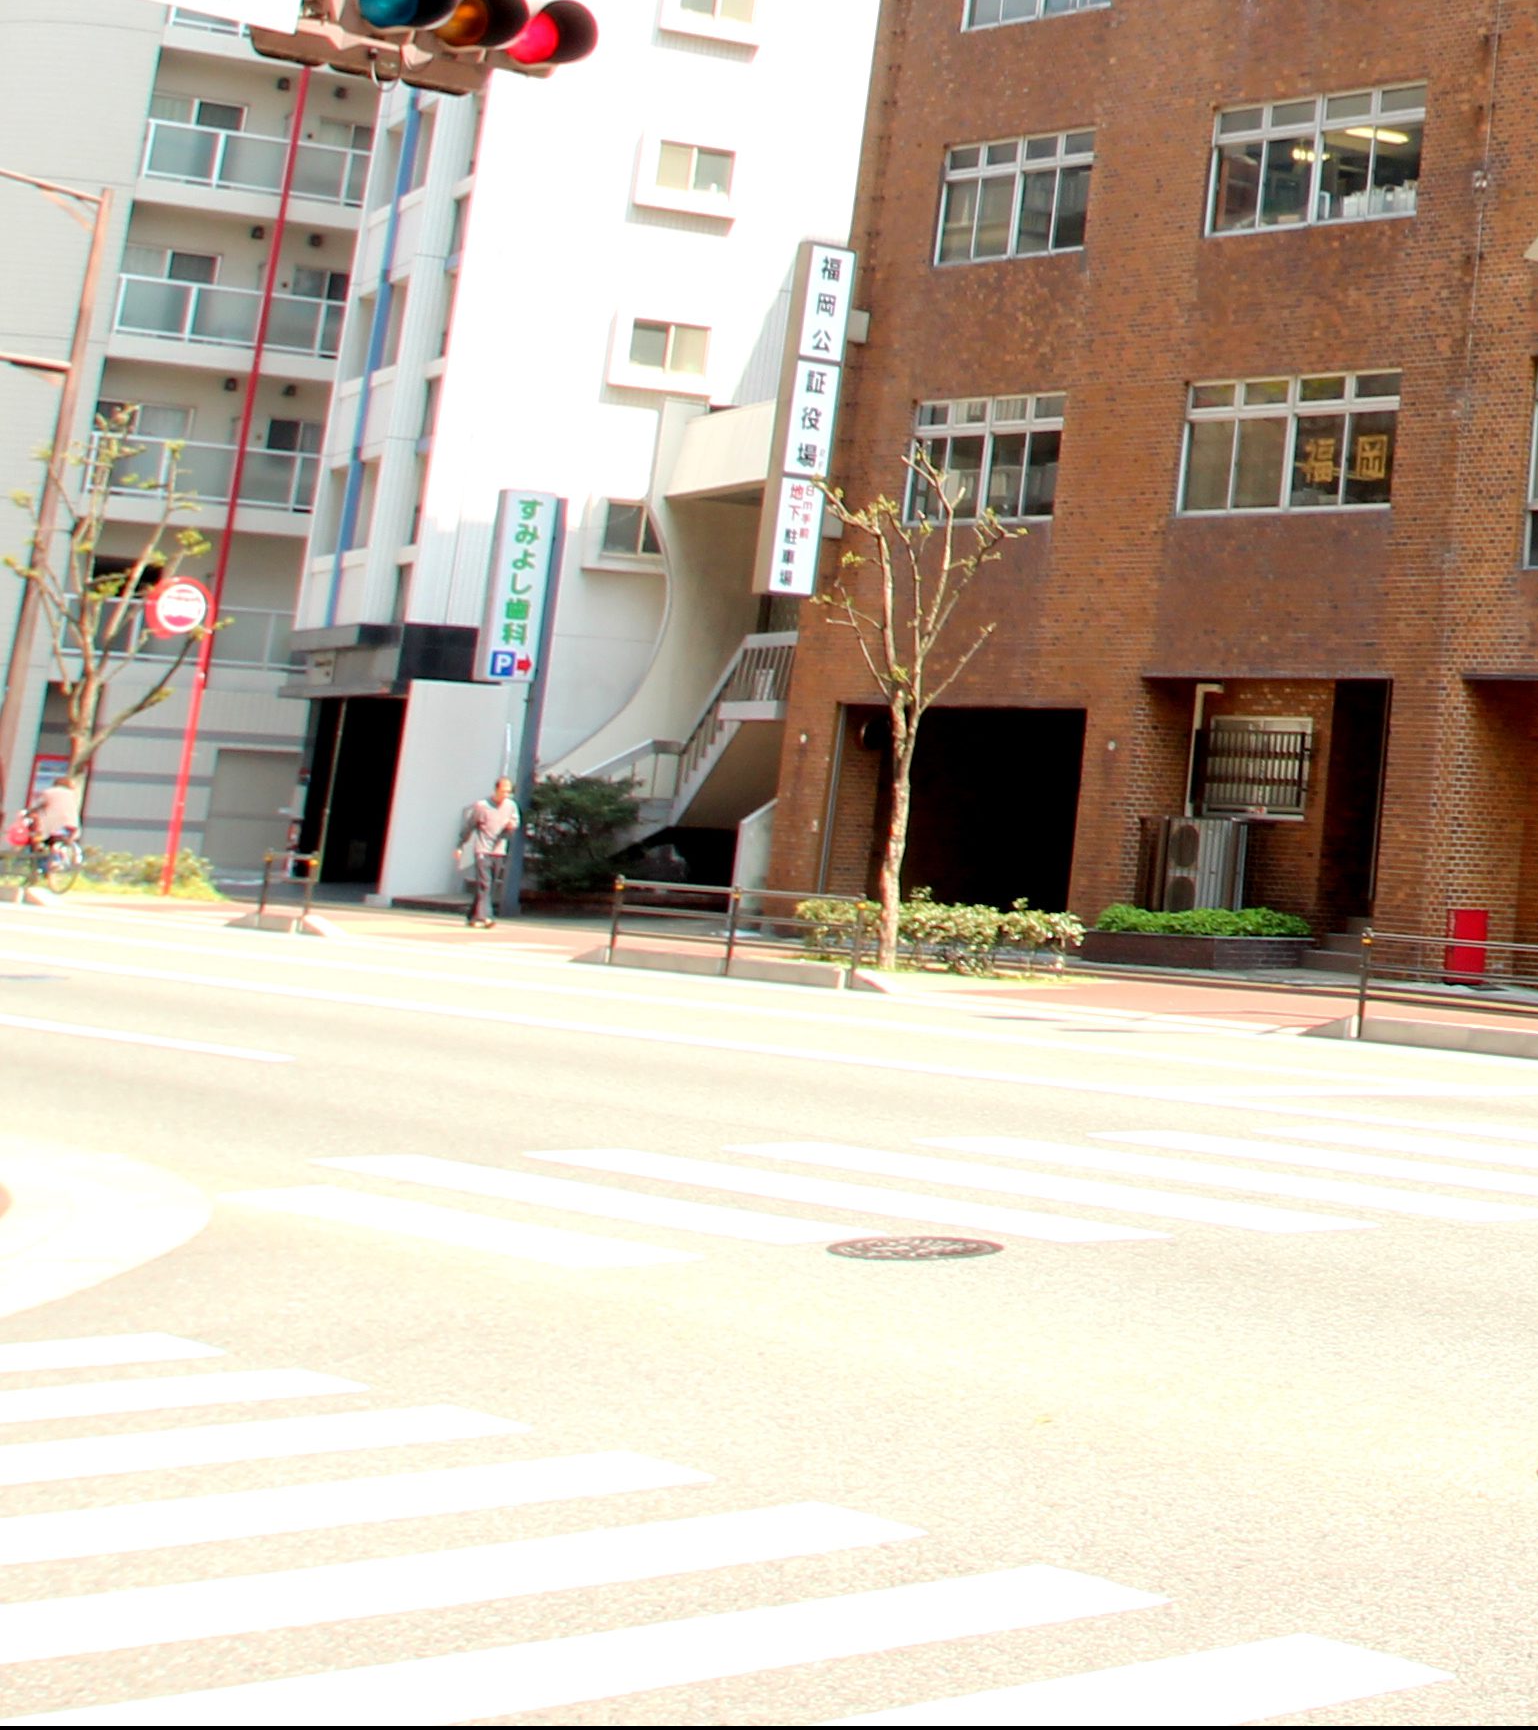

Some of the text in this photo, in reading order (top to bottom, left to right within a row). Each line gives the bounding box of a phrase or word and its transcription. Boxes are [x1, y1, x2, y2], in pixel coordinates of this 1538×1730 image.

[796, 255, 842, 468] 福岡公証役場
[501, 498, 543, 645] すみよし歯科
[779, 484, 804, 586] 地下駐車場
